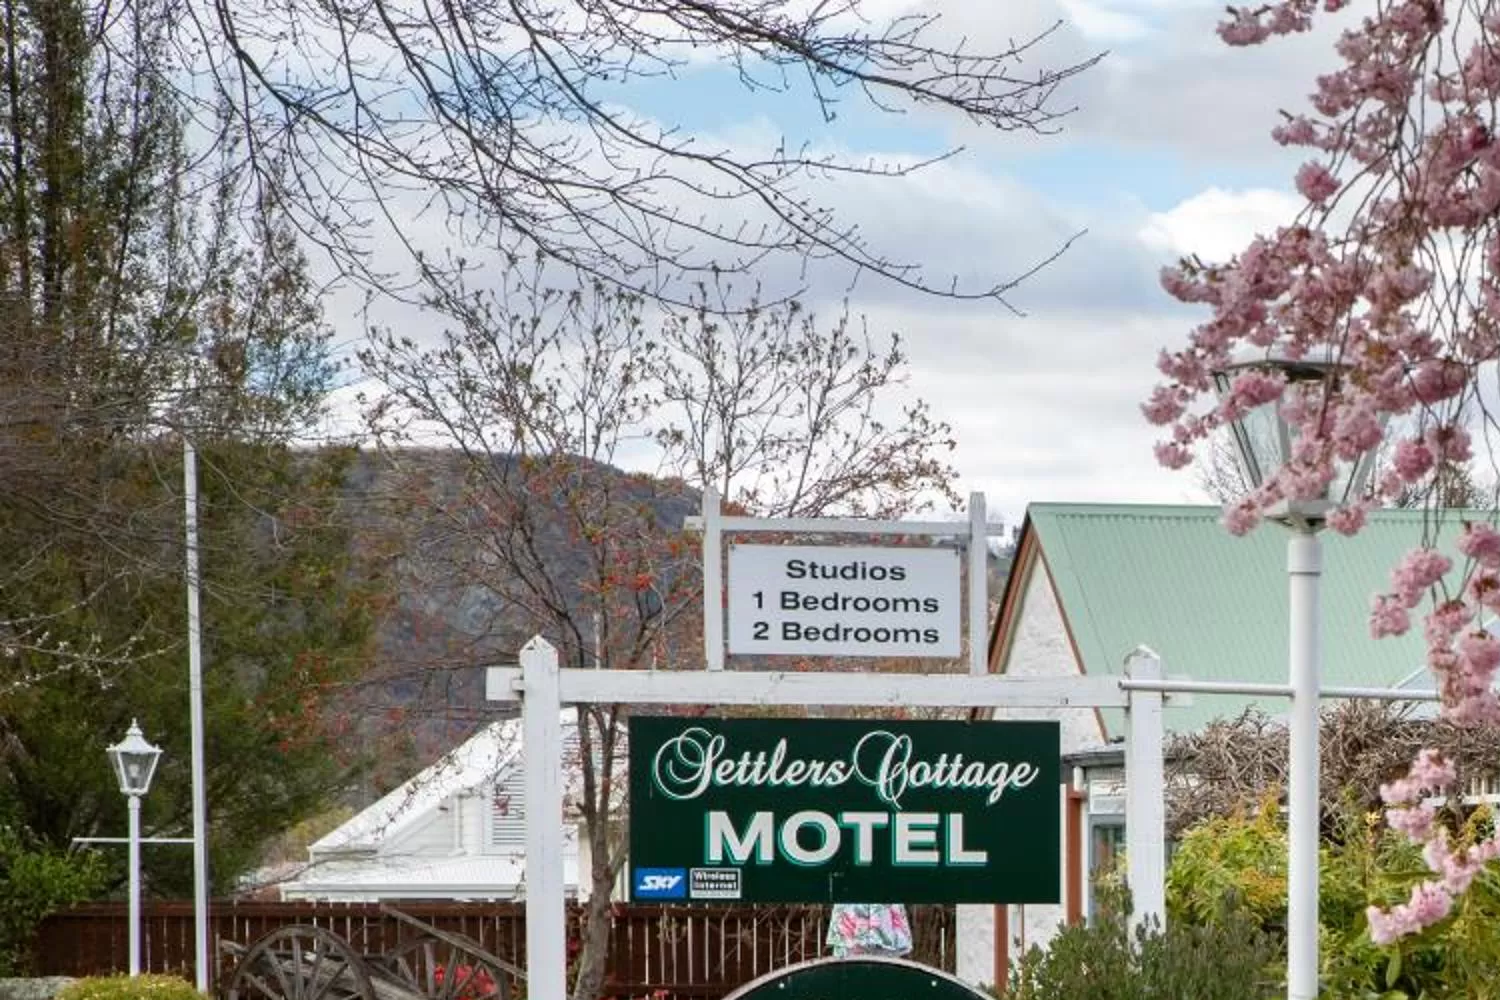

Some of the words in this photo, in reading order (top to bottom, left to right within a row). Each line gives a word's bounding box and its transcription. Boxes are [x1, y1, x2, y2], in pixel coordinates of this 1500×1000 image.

[786, 559, 906, 581] Studios
[753, 591, 763, 609] 1
[780, 591, 939, 613] Bedrooms
[753, 622, 769, 641] 2
[782, 621, 939, 643] Bedrooms
[655, 727, 854, 800] Settlers
[854, 730, 1039, 810] Cottage
[705, 811, 988, 865] MOTEL
[638, 875, 682, 891] SKY
[694, 871, 737, 881] Wireless
